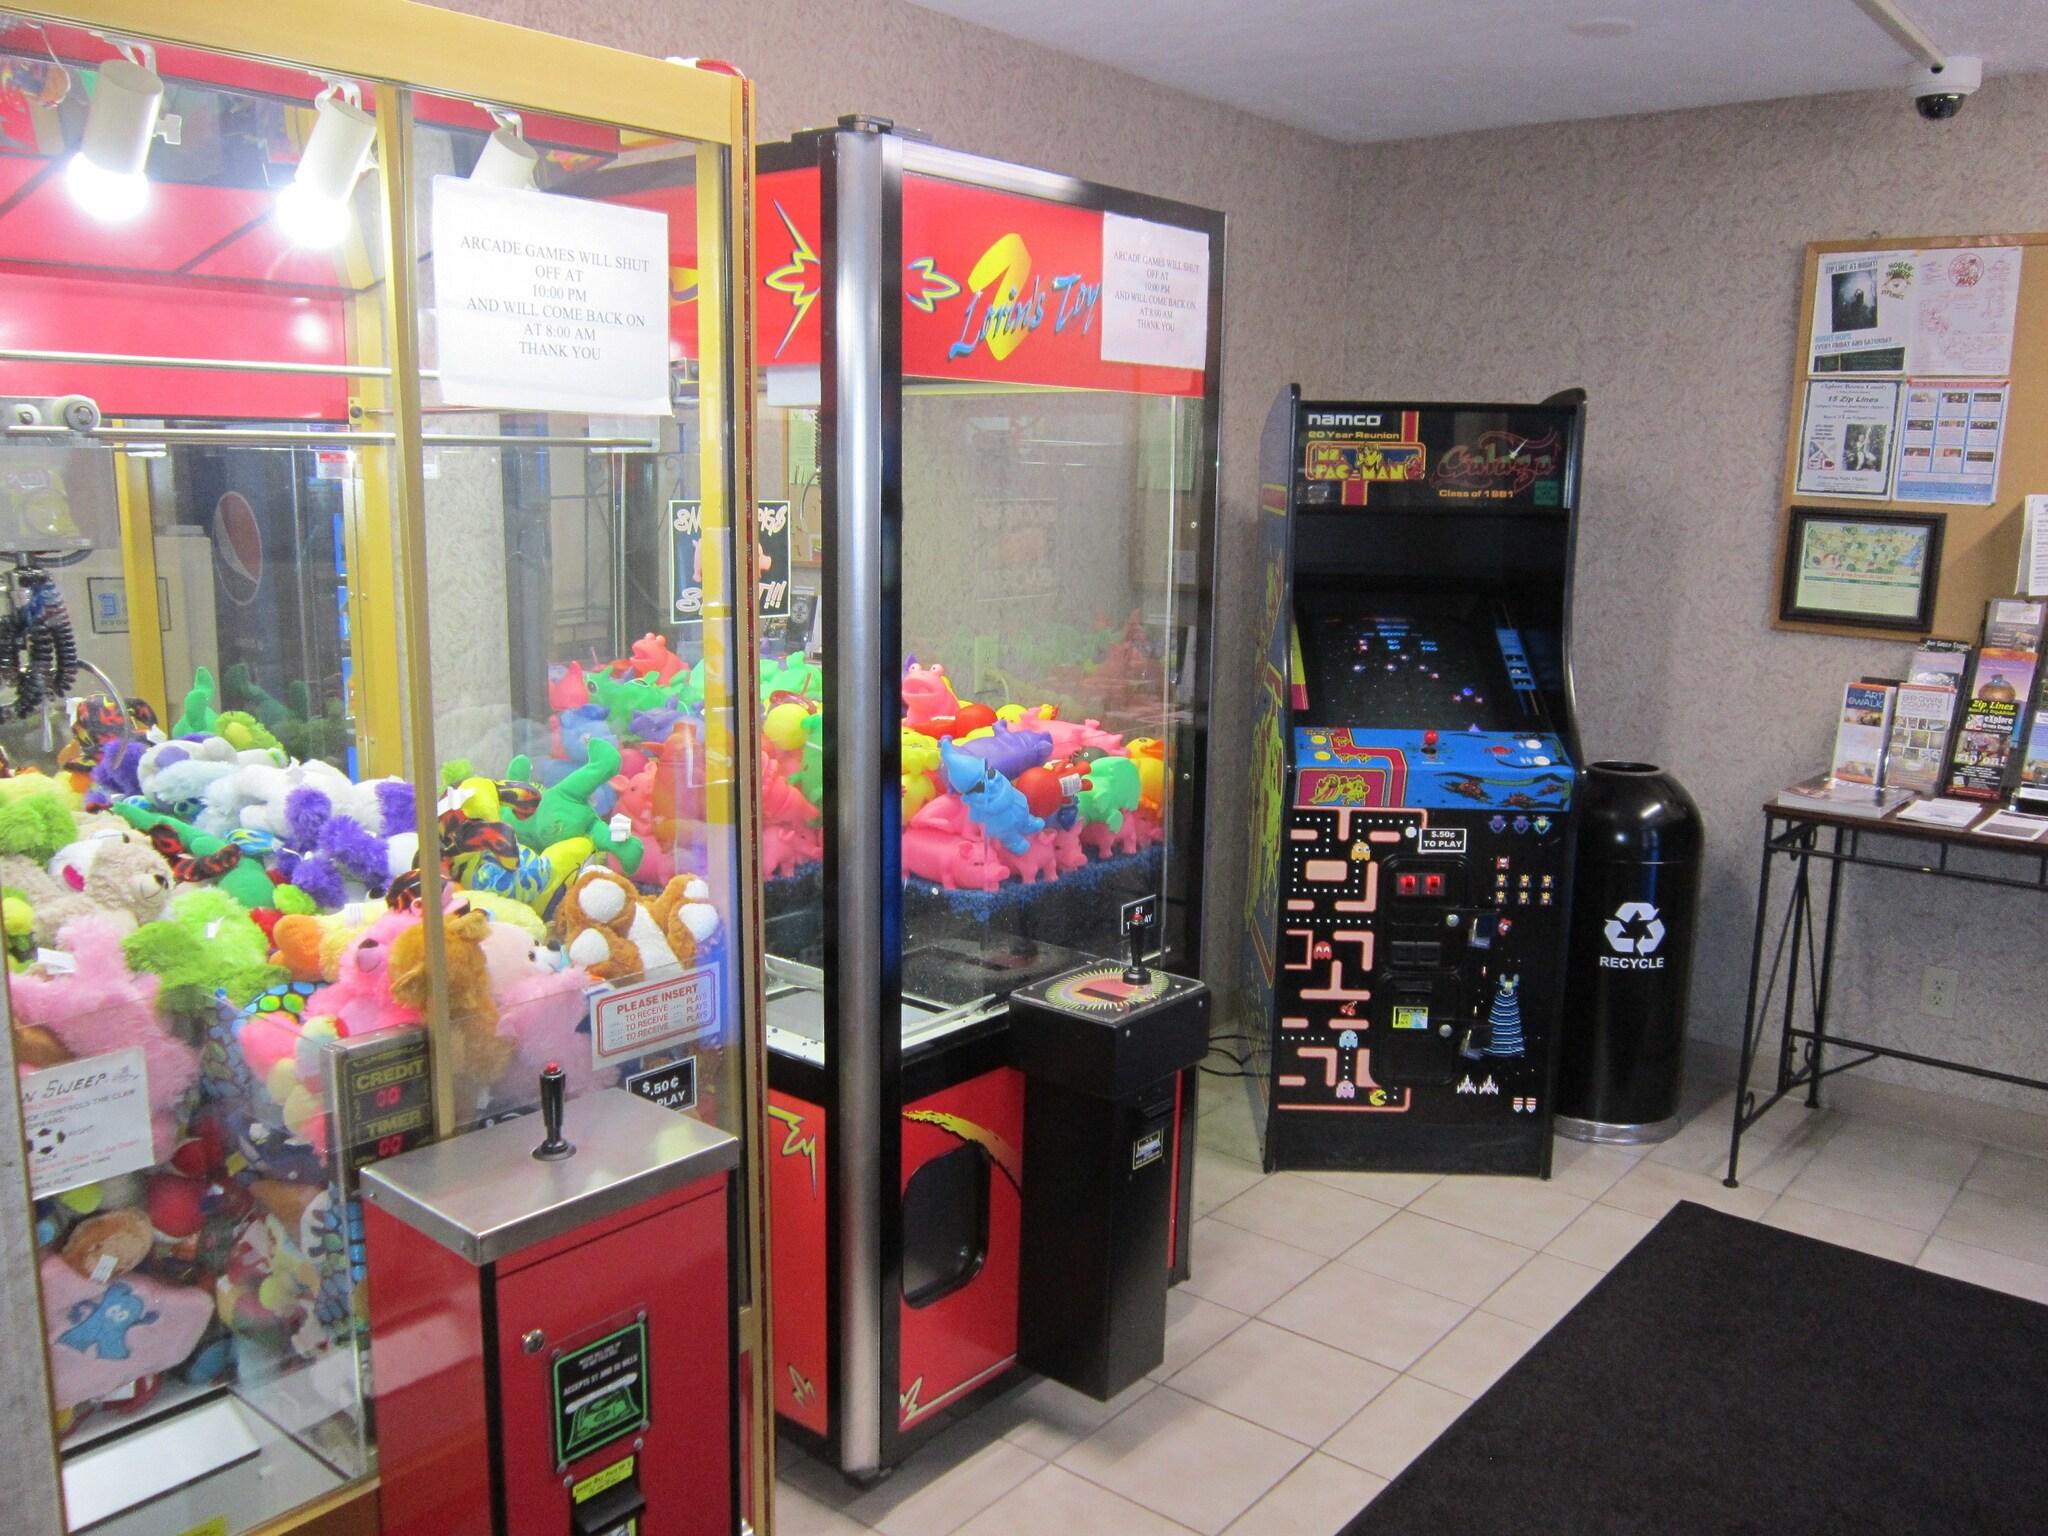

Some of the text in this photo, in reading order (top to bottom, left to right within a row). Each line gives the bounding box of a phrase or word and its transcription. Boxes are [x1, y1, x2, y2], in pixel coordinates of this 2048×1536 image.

[461, 236, 649, 273] ARCADE GAMES WILL SHUT
[1113, 251, 1199, 273] ARCADE GAMES WILL SHUT
[535, 265, 584, 283] OFF AT
[1147, 269, 1168, 281] OFF AT
[532, 284, 587, 302] 10:00 PM
[1160, 284, 1170, 293] PM
[1115, 290, 1196, 309] AND WILL COME BACK ON
[467, 297, 645, 328] AND WILL COME BACK ON
[1139, 307, 1149, 316] AT
[1162, 310, 1173, 319] AM
[523, 323, 596, 342] AT 8:00 AM
[1137, 319, 1175, 332] THANK YOU
[519, 341, 602, 361] THANK YOU
[1308, 414, 1382, 426] namco
[1355, 431, 1400, 439] Reunion
[1439, 489, 1469, 498] Class
[1471, 490, 1482, 498] of
[1972, 700, 1987, 710] Zip
[1990, 702, 2014, 710] Lines
[1599, 956, 1665, 969] RECYCLE
[616, 984, 698, 1014] PLEASE INSERT
[625, 1023, 636, 1031] TO
[637, 1013, 669, 1028] RECEIVE
[626, 1013, 636, 1022] TO
[637, 1004, 669, 1019] RECEIVE
[625, 1032, 636, 1041] TO
[637, 1022, 669, 1038] RECEIVE
[356, 1060, 424, 1090] CREDIT
[656, 1091, 686, 1106] PLAY
[368, 1111, 420, 1137] TIMER
